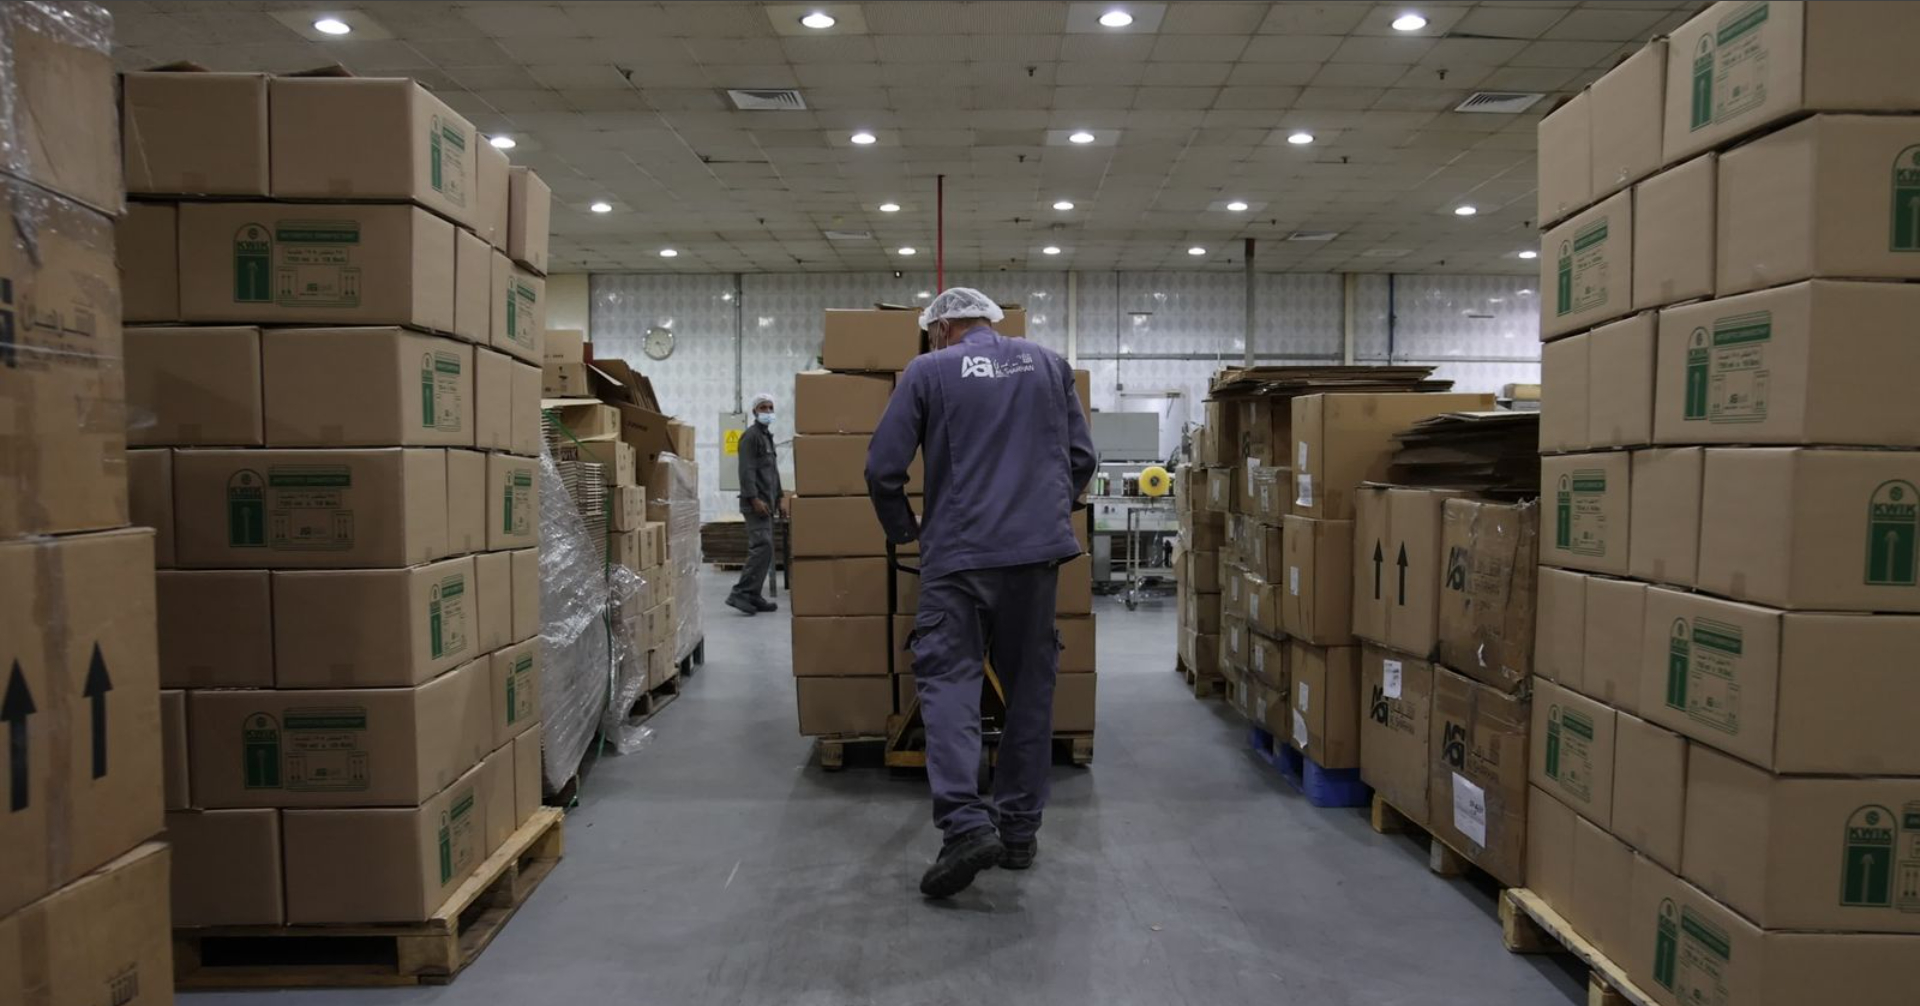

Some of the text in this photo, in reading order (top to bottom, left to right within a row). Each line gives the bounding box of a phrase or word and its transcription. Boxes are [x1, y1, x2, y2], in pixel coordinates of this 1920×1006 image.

[1897, 169, 1920, 180] KW
[236, 241, 270, 250] KWIK
[1873, 503, 1917, 515] KWIK
[1849, 827, 1892, 840] KWIK
